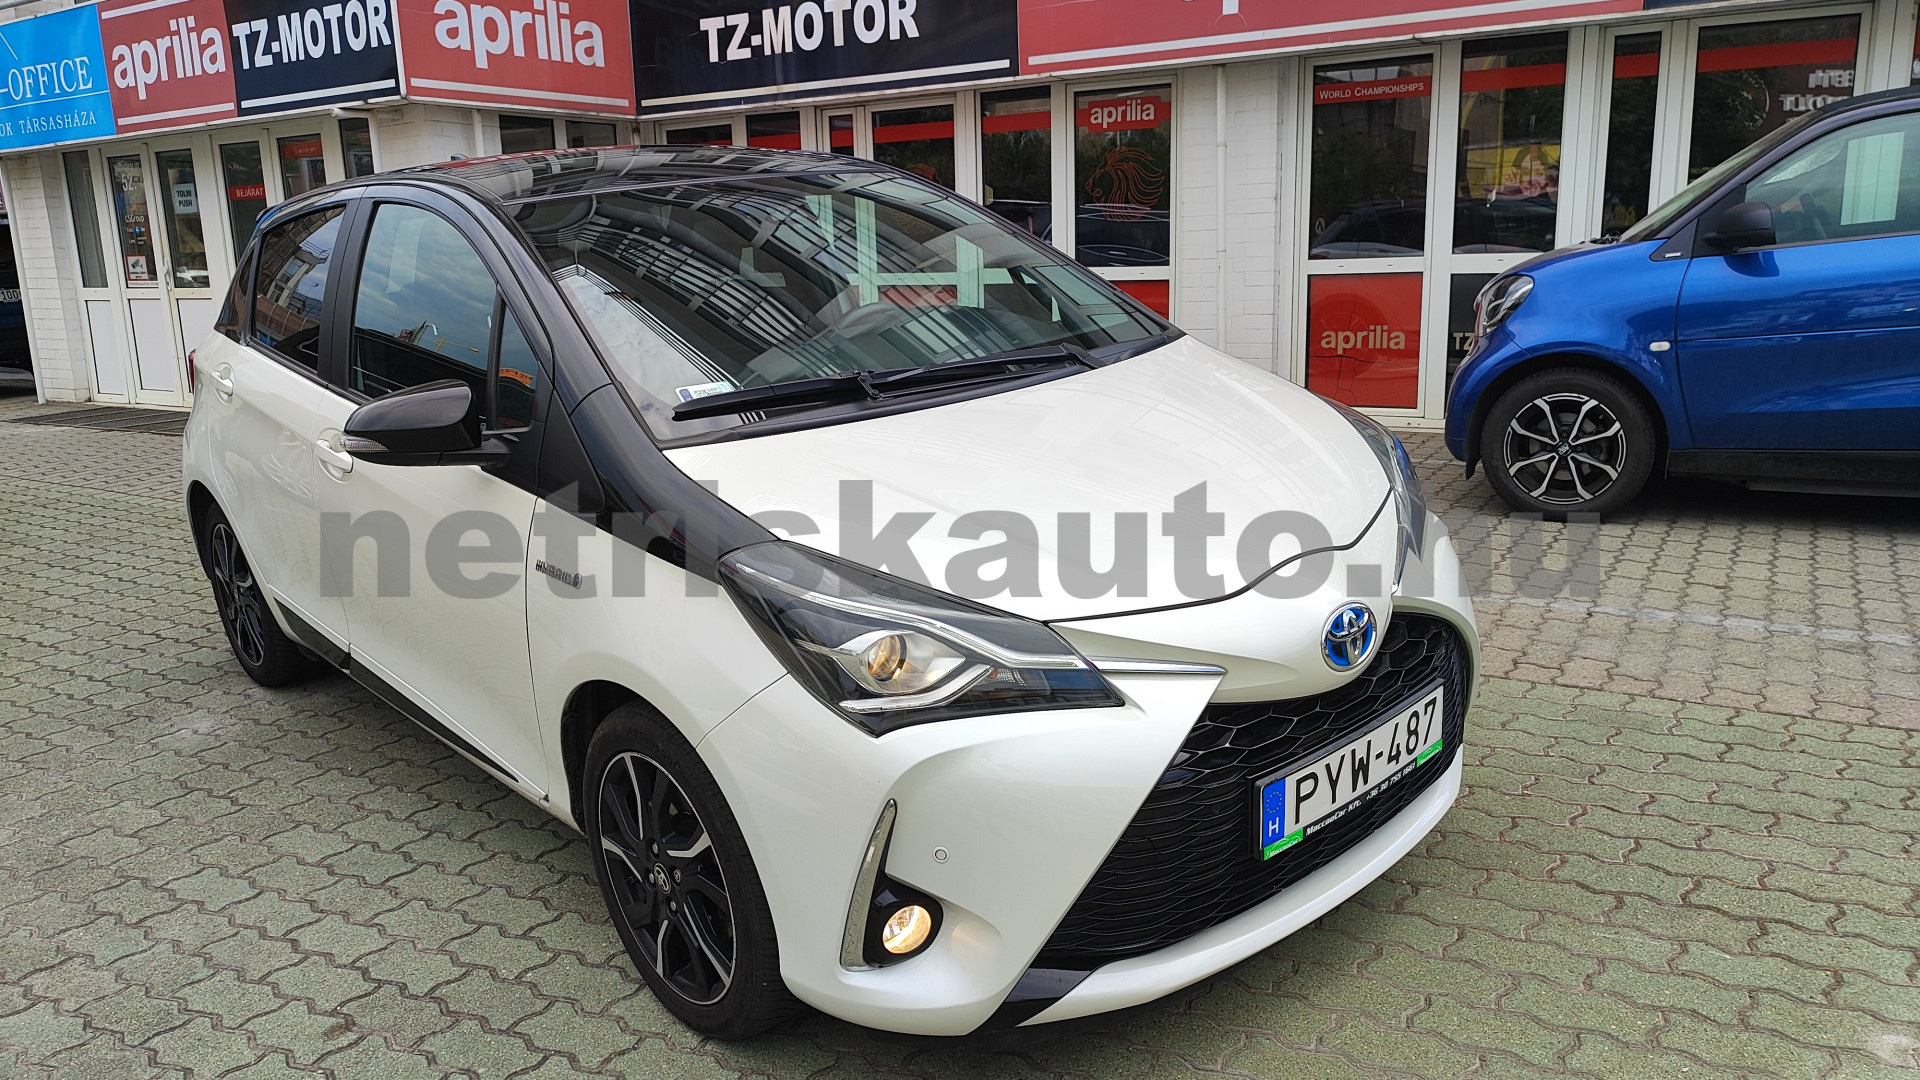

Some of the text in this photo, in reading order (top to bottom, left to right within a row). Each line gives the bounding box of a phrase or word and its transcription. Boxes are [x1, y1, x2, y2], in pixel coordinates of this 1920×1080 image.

[232, 0, 391, 69] TZ-MOTOR
[433, 0, 605, 69] aprilia
[700, 0, 919, 63] TZ-MOTOR
[112, 16, 226, 100] aprilia
[19, 109, 96, 134] TÁRSASHÁZA
[1090, 99, 1155, 129] aprilia
[178, 199, 193, 208] PUSH
[236, 186, 264, 198] BEJÁRAT
[1320, 325, 1406, 355] aprilia
[1295, 696, 1437, 824] PYW-487
[1268, 816, 1279, 837] H
